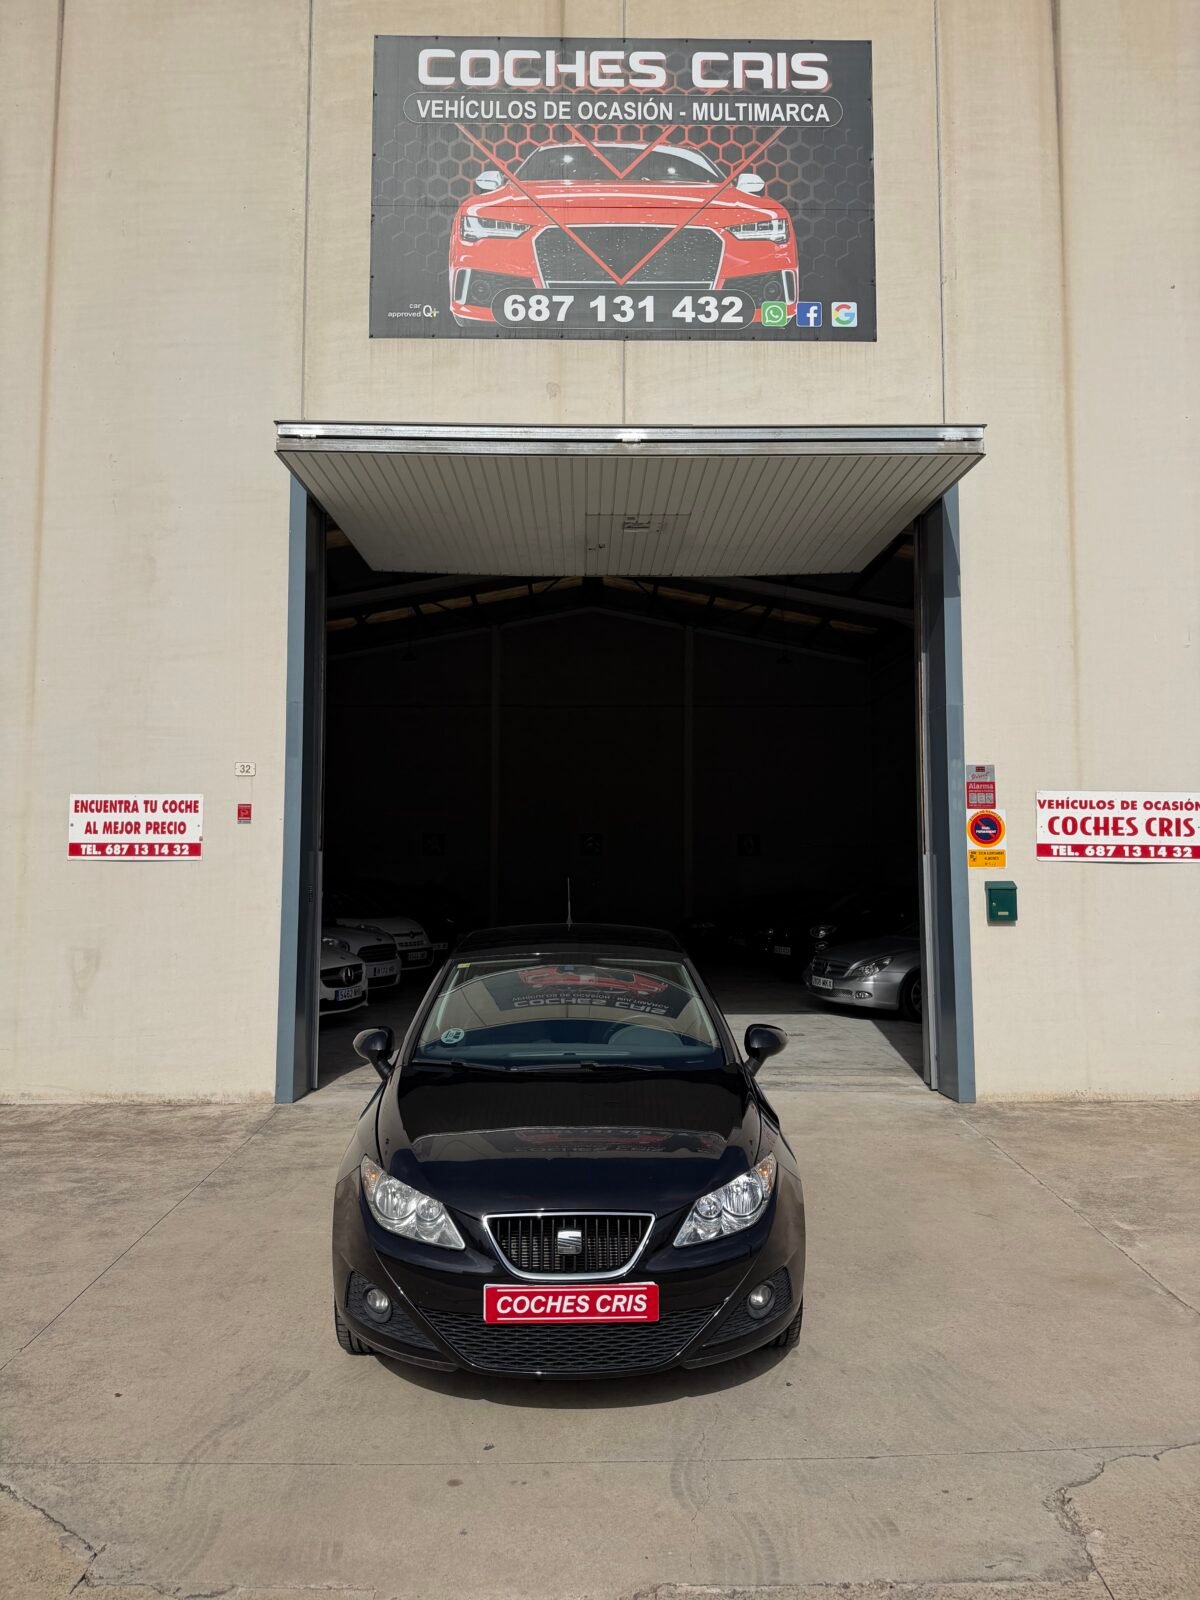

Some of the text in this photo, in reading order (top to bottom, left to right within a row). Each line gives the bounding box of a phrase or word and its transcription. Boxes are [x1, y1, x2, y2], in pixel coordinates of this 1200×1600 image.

[418, 49, 829, 90] COCHES CRIS
[416, 96, 537, 119] VEHÍCULOS
[543, 101, 571, 120] DE
[577, 98, 673, 121] OCASIÓN
[692, 102, 830, 122] MULTIMARCA
[503, 294, 744, 323] 687 131 432
[239, 764, 251, 774] 32
[74, 800, 199, 814] ENCUENTRA TU COCHE
[1037, 797, 1115, 810] VEHÍCULOS
[1121, 801, 1138, 811] DE
[84, 821, 187, 835] AL MEJOR PRECIO
[1048, 816, 1196, 837] COCHES CRIS
[80, 844, 189, 855] TEL. 687 13 14 32
[1051, 845, 1193, 858] TEL. 687 13 14 32
[496, 1294, 648, 1314] COCHES CRIS
